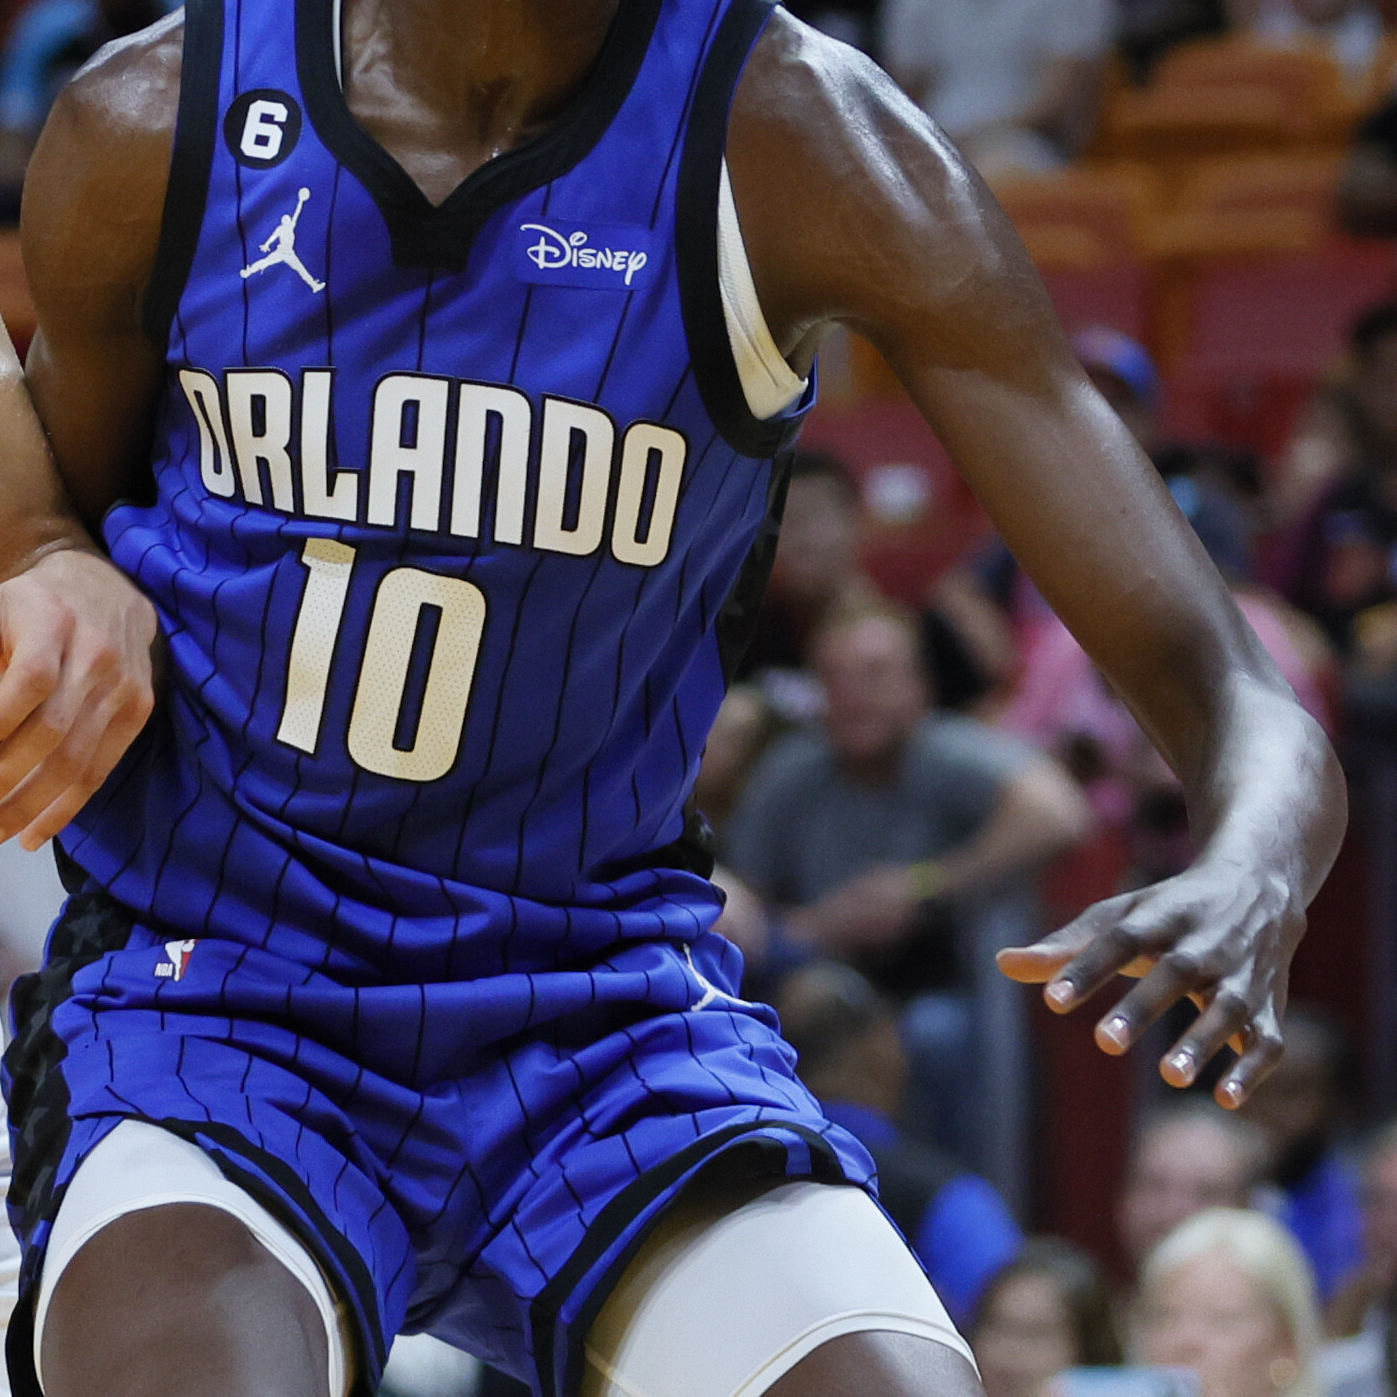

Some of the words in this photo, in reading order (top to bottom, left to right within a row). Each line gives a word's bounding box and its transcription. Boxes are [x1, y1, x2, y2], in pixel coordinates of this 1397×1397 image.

[240, 100, 288, 160] 6
[178, 368, 687, 567] ORLANDO
[277, 538, 486, 782] 10
[154, 962, 174, 977] NBA
